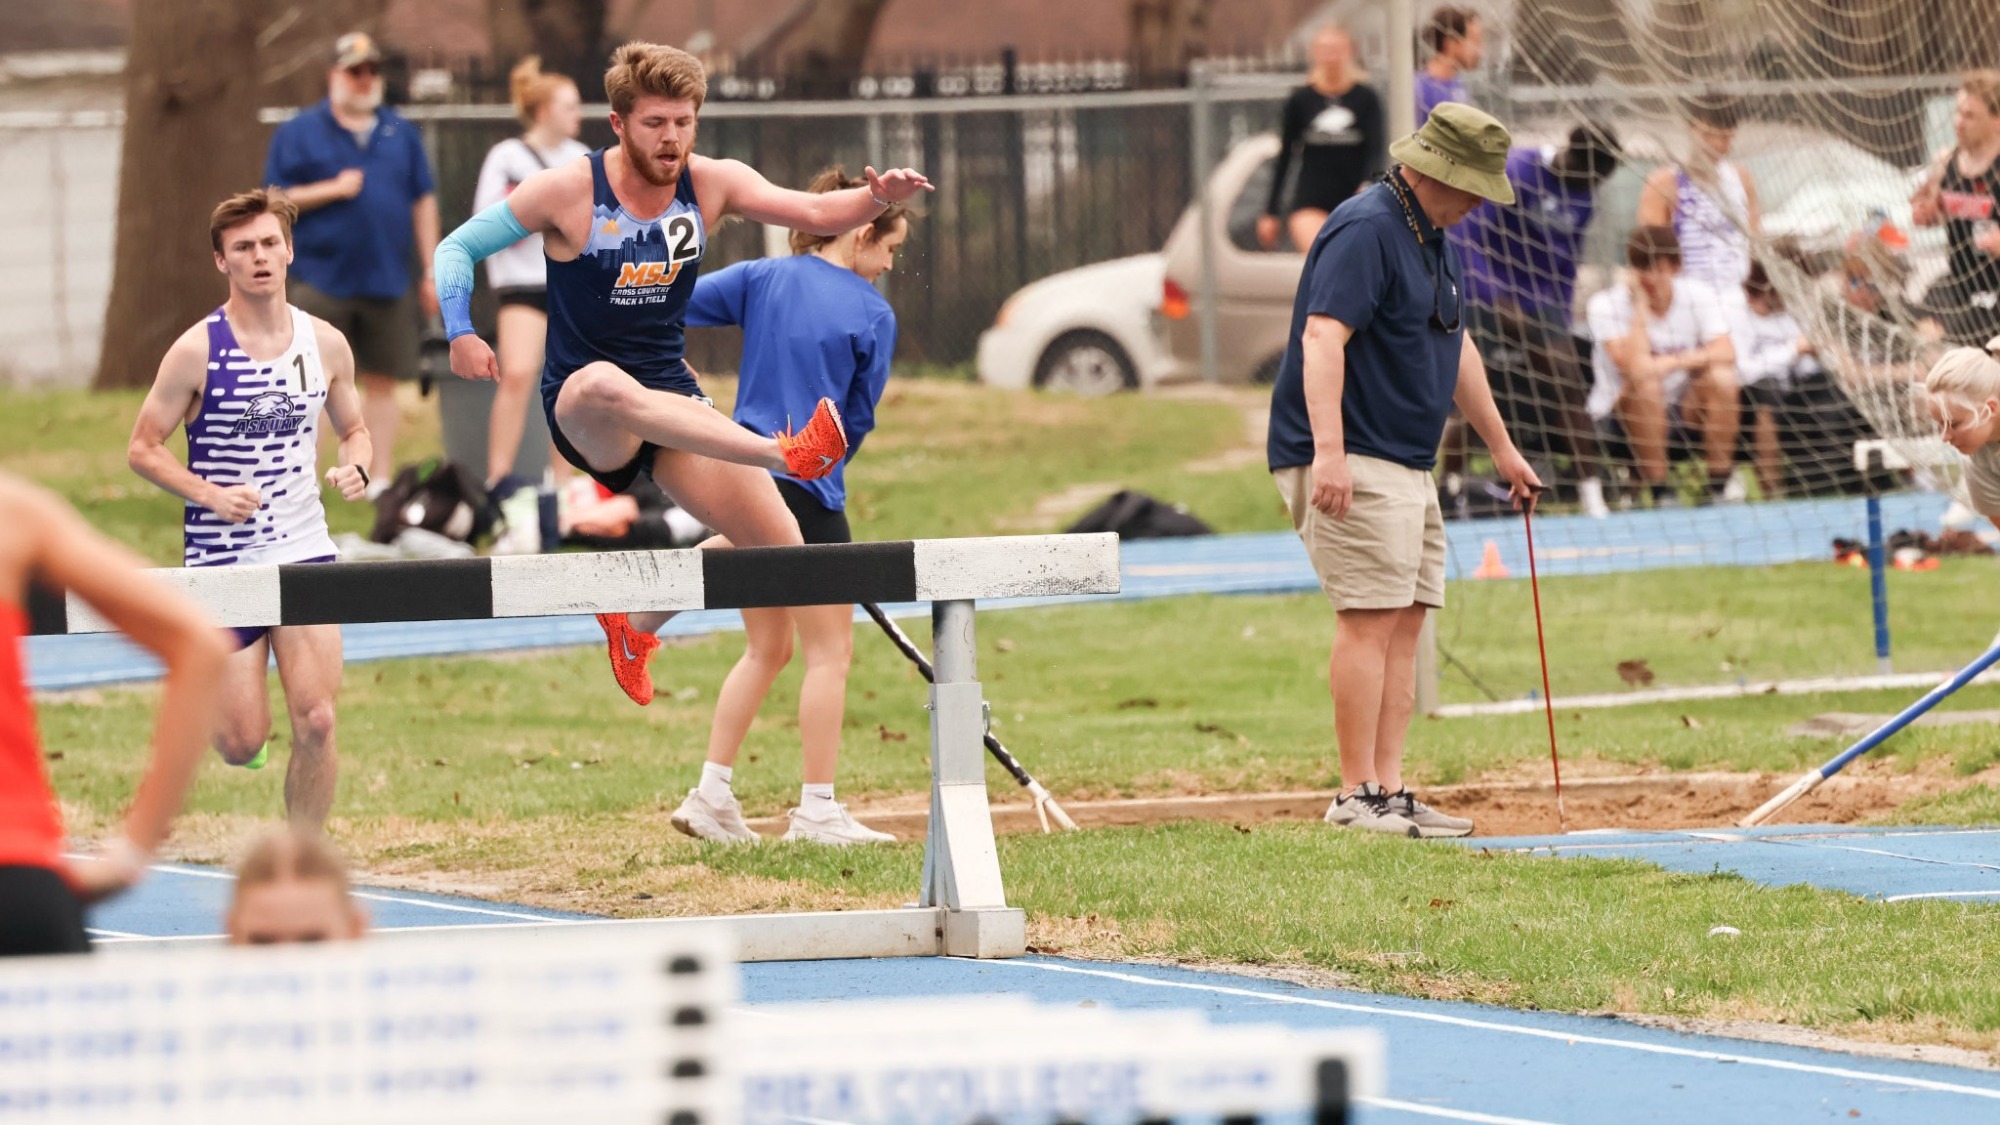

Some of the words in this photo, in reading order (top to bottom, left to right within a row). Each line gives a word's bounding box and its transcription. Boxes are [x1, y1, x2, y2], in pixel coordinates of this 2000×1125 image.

[668, 217, 697, 260] 2
[614, 261, 682, 287] MSJ
[609, 297, 637, 306] TRACK
[638, 297, 644, 305] &
[644, 295, 667, 304] FIELD
[611, 288, 637, 296] CROSS
[637, 286, 671, 295] COUNTRY
[292, 354, 306, 392] 1
[234, 416, 304, 433] ASBURY
